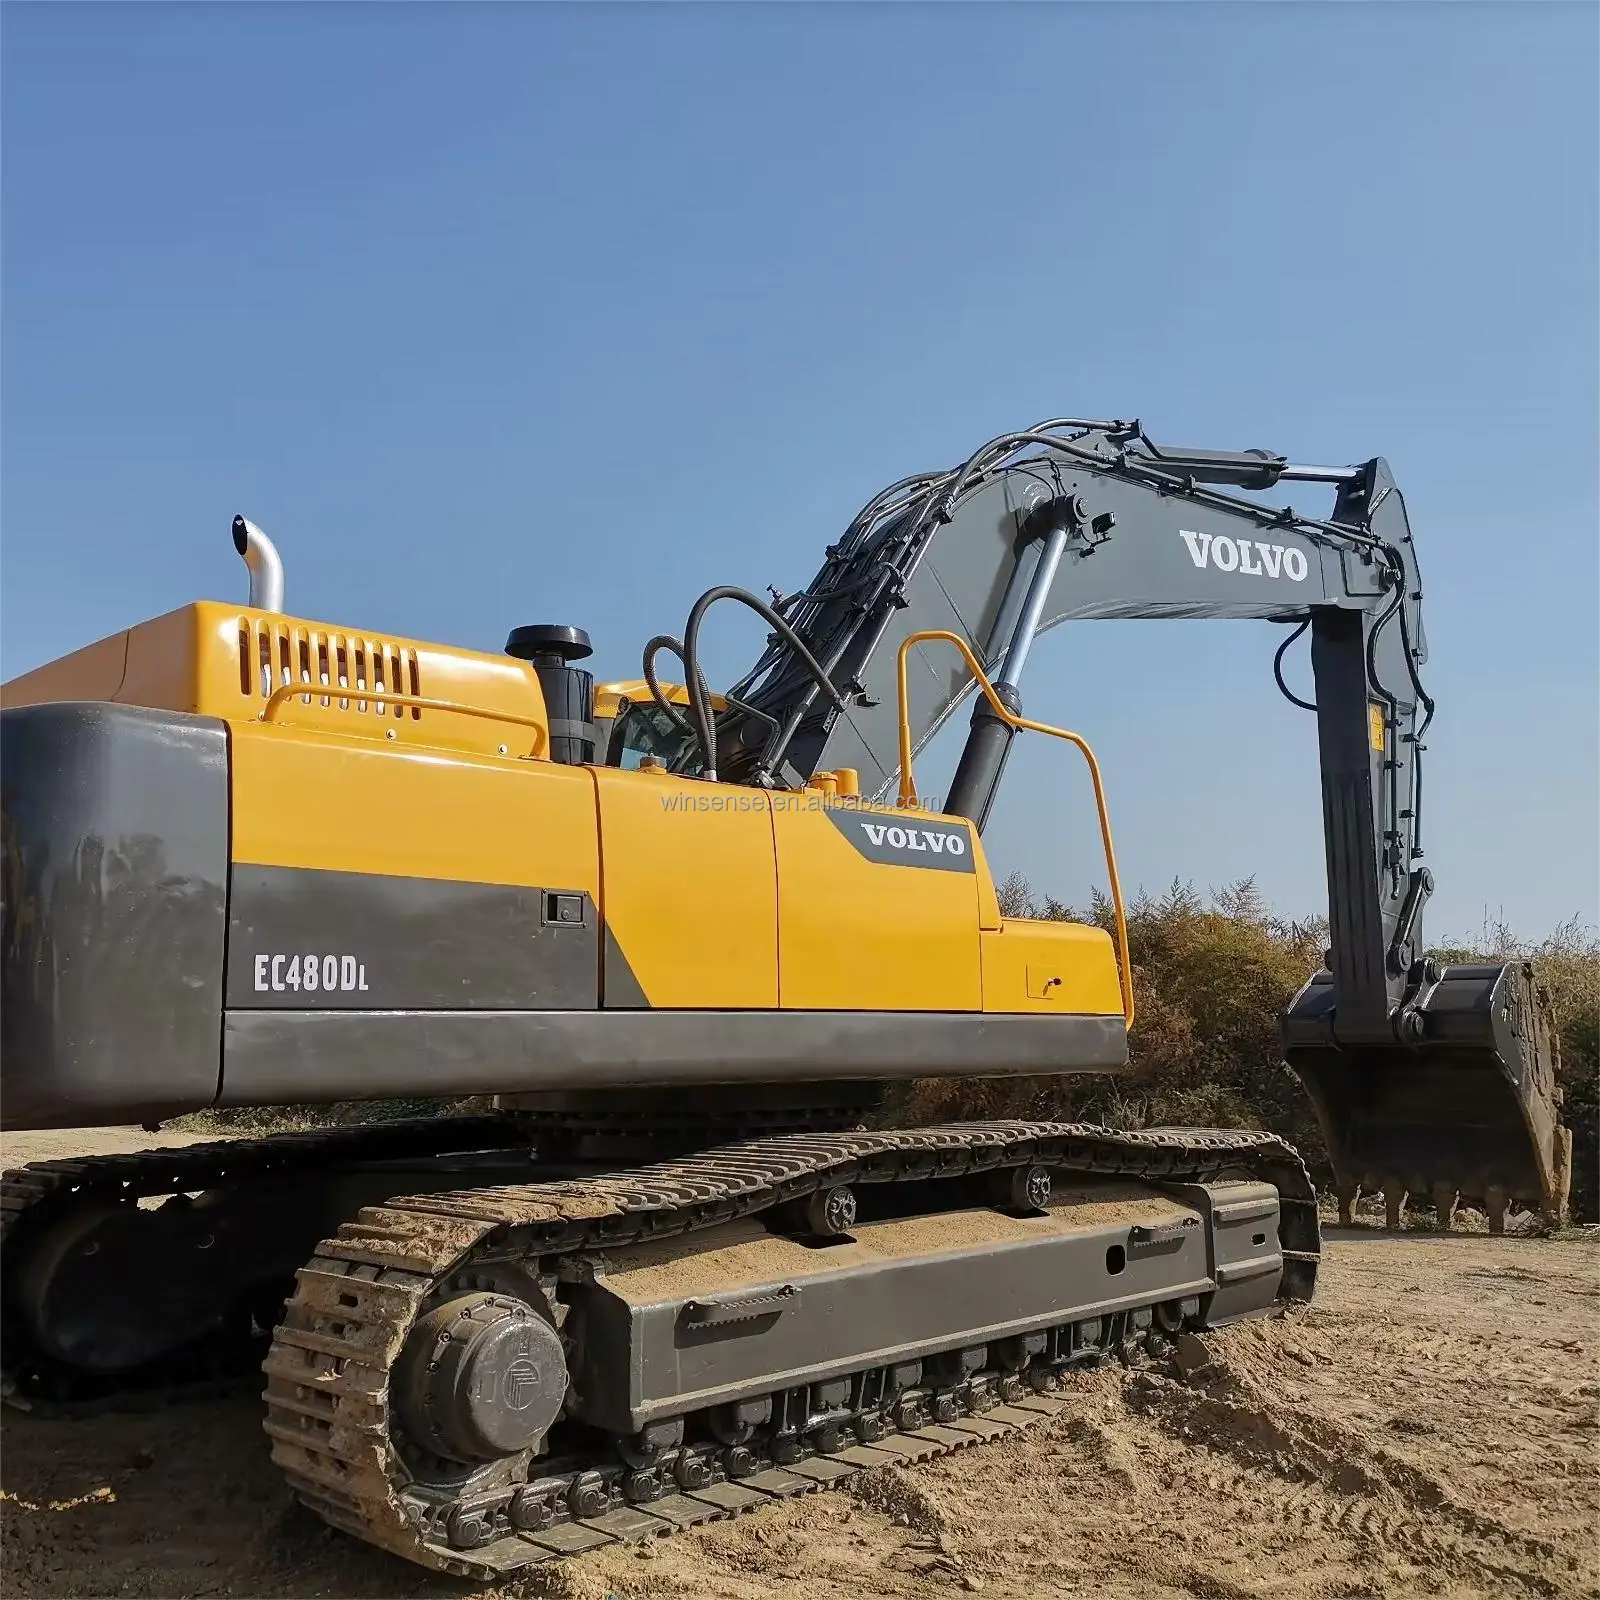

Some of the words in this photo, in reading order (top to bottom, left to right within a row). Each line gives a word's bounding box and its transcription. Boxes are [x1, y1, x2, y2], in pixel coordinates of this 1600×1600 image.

[1179, 529, 1308, 582] VOLVO
[860, 822, 965, 856] VOLVO
[254, 954, 369, 992] EC480DL
